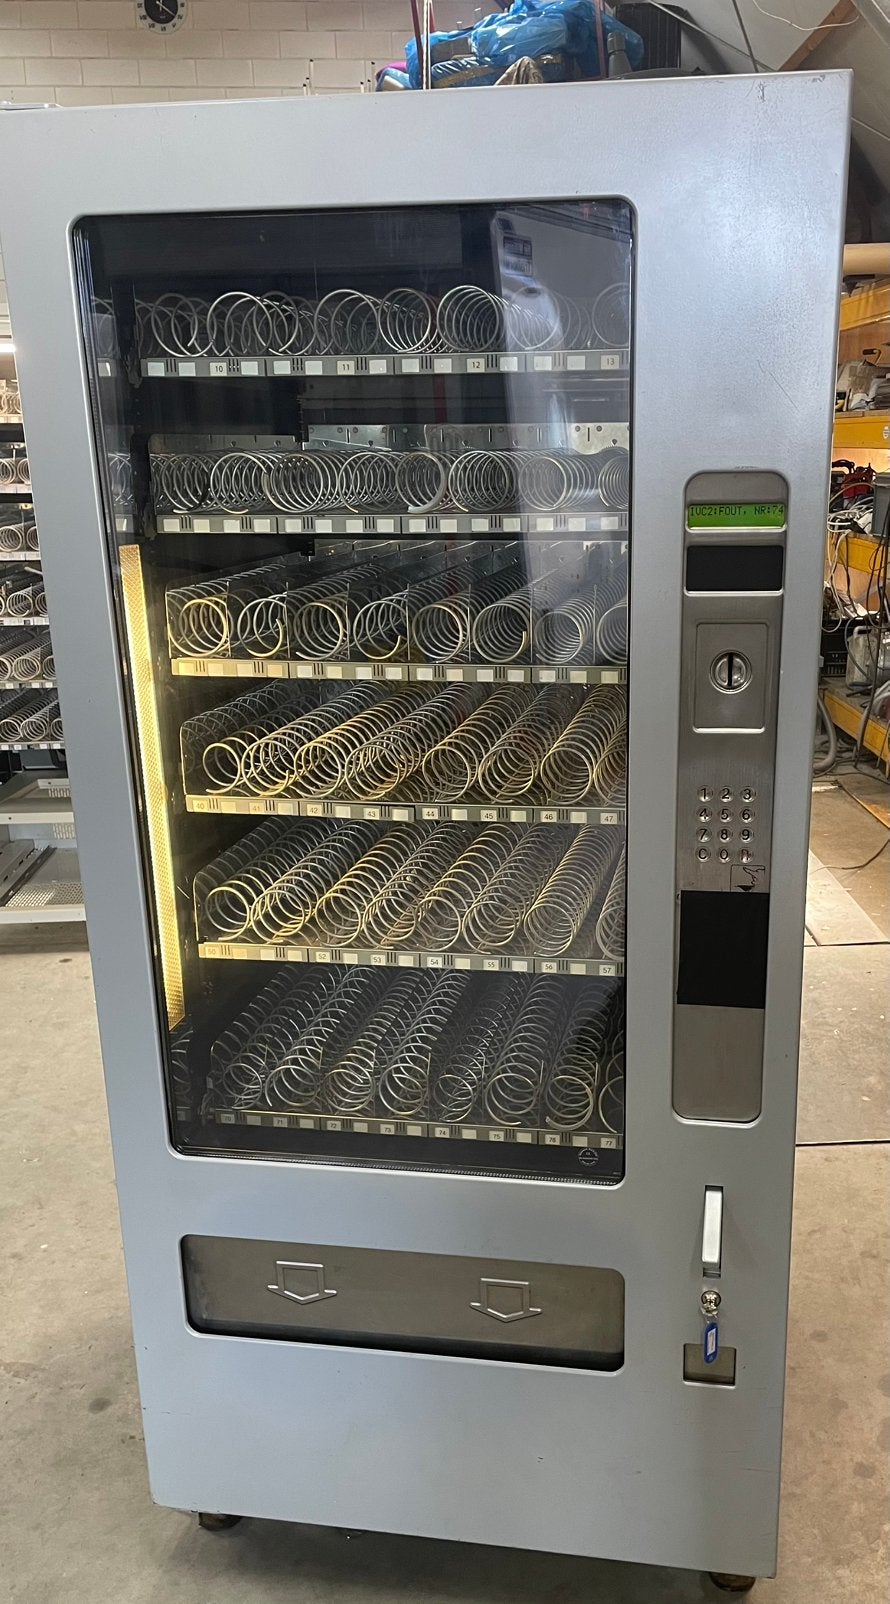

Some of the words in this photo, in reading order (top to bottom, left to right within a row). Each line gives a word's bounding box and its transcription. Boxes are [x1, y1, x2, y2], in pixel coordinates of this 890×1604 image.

[606, 357, 614, 365] 13
[754, 505, 784, 515] NR:74
[701, 788, 707, 799] 1
[722, 788, 730, 799] 2
[743, 788, 752, 800] 3
[700, 808, 708, 819] 4
[721, 808, 729, 820] 5
[742, 809, 750, 820] 6
[700, 829, 707, 840] 7
[721, 829, 728, 840] 8
[742, 829, 750, 841] 9
[699, 848, 707, 860] C
[720, 849, 728, 860] 0
